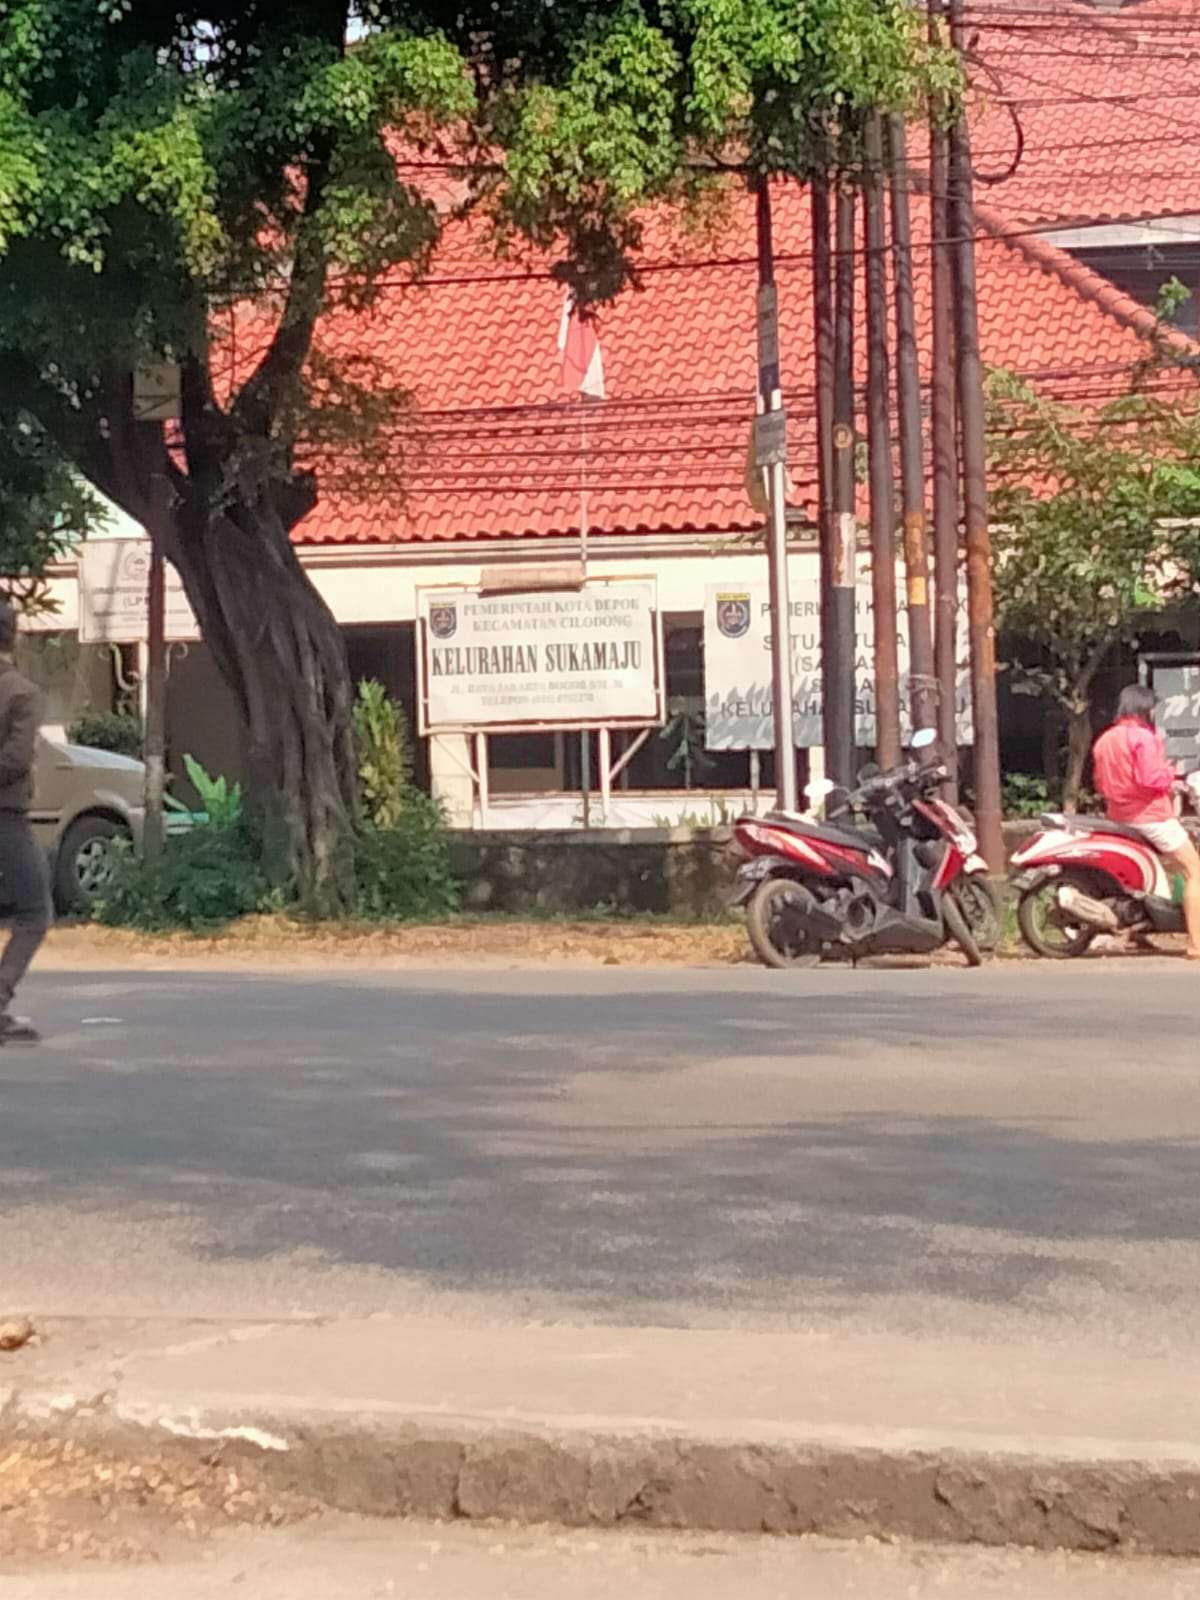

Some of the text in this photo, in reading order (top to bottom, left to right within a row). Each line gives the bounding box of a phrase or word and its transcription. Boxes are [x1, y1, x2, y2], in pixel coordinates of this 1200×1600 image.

[555, 600, 591, 613] KOTA
[595, 598, 639, 612] DEPOK
[559, 615, 632, 629] CILODONG
[432, 641, 641, 676] KELURAHAN SUKAMAJU
